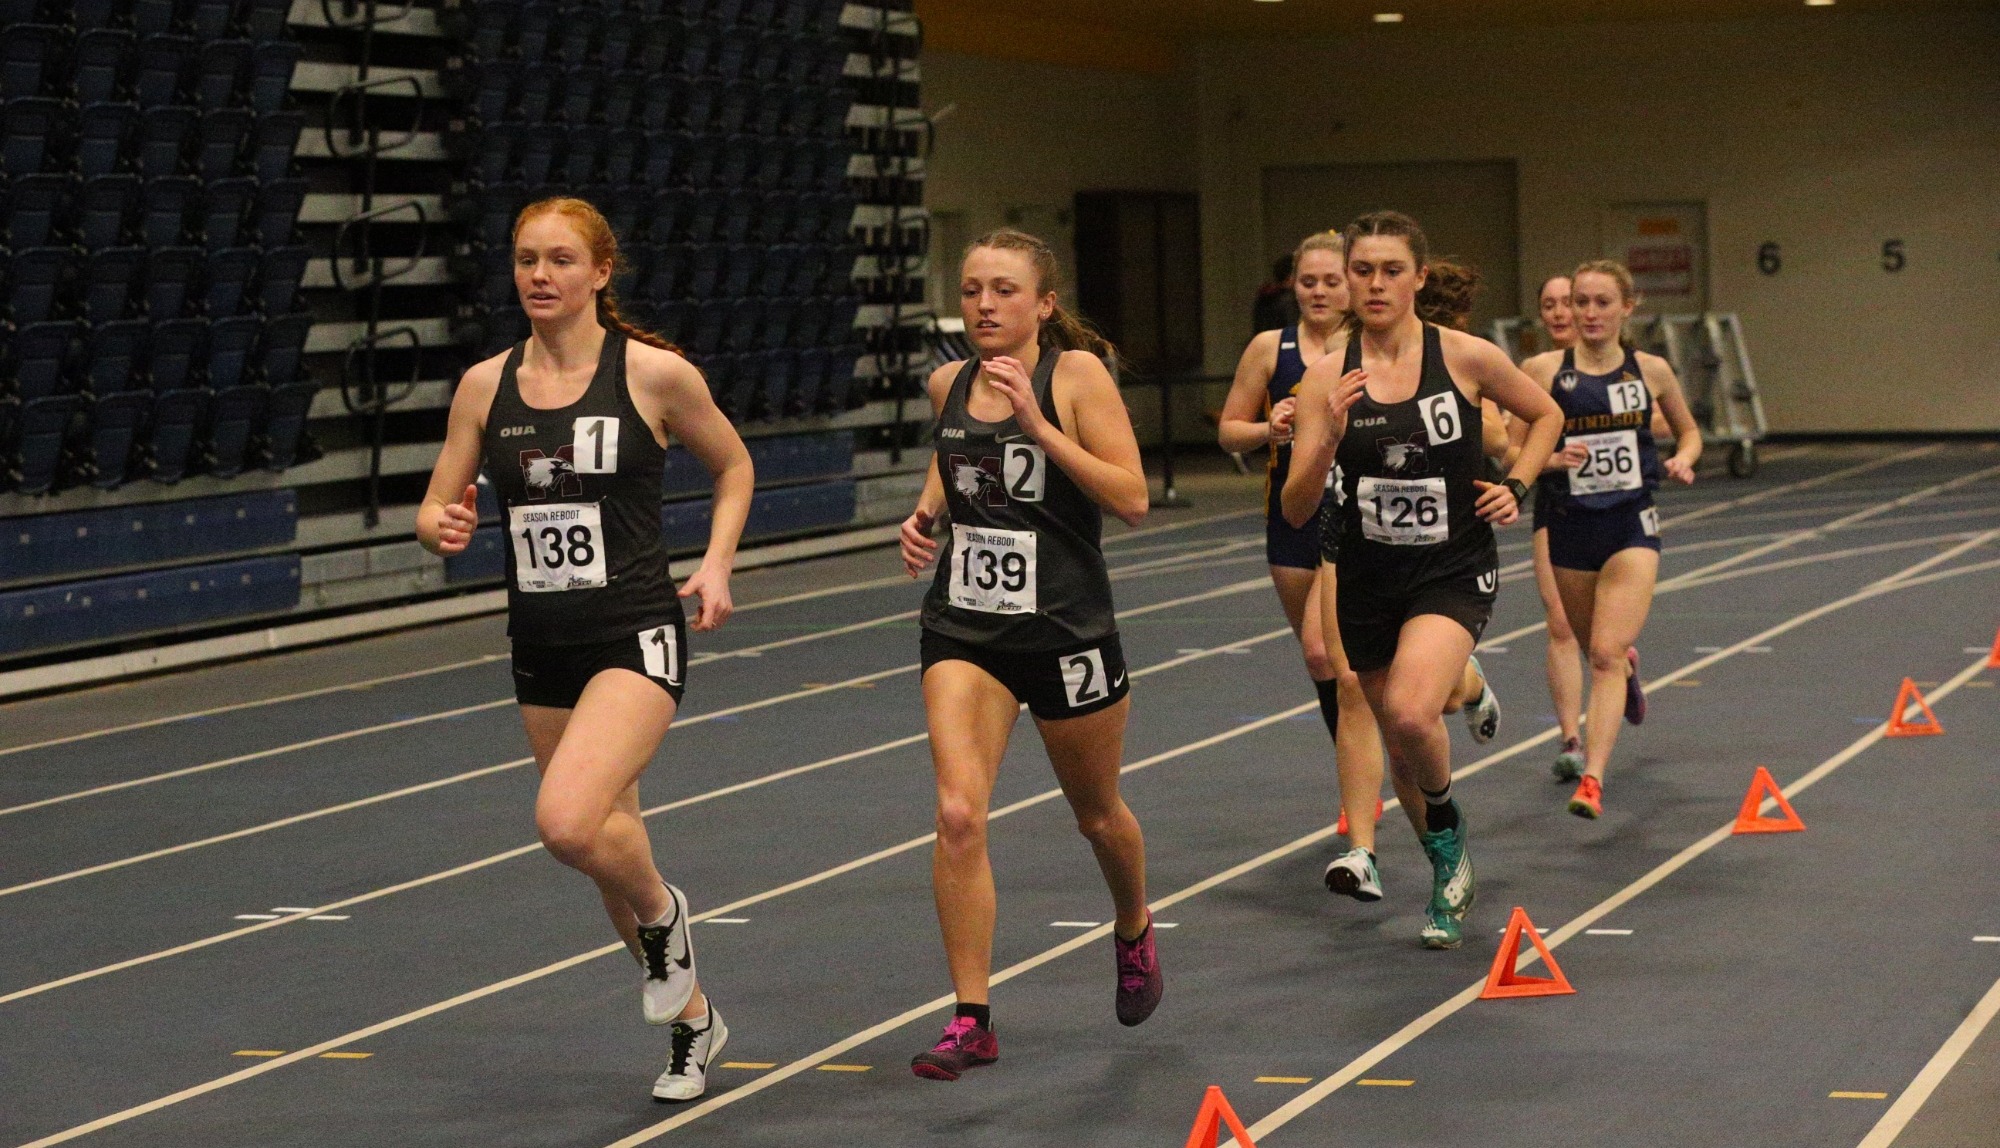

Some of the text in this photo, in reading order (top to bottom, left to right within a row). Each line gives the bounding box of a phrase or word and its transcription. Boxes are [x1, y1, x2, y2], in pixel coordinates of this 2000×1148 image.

[1757, 241, 1781, 275] 6
[1882, 239, 1906, 272] 5
[1617, 383, 1641, 410] 13
[500, 425, 536, 438] OUA
[941, 428, 966, 440] OUA
[1353, 415, 1388, 428] OUA
[1430, 396, 1455, 440] 6
[586, 419, 605, 470] 1
[1012, 447, 1036, 499] 2
[1577, 446, 1633, 479] 256
[522, 509, 580, 523] SEASON REBOOT
[1369, 495, 1439, 528] 126
[521, 525, 595, 570] 138
[988, 535, 1016, 547] REBOOT
[961, 546, 1027, 593] 139
[650, 628, 670, 676] 1
[1069, 655, 1101, 704] 2
